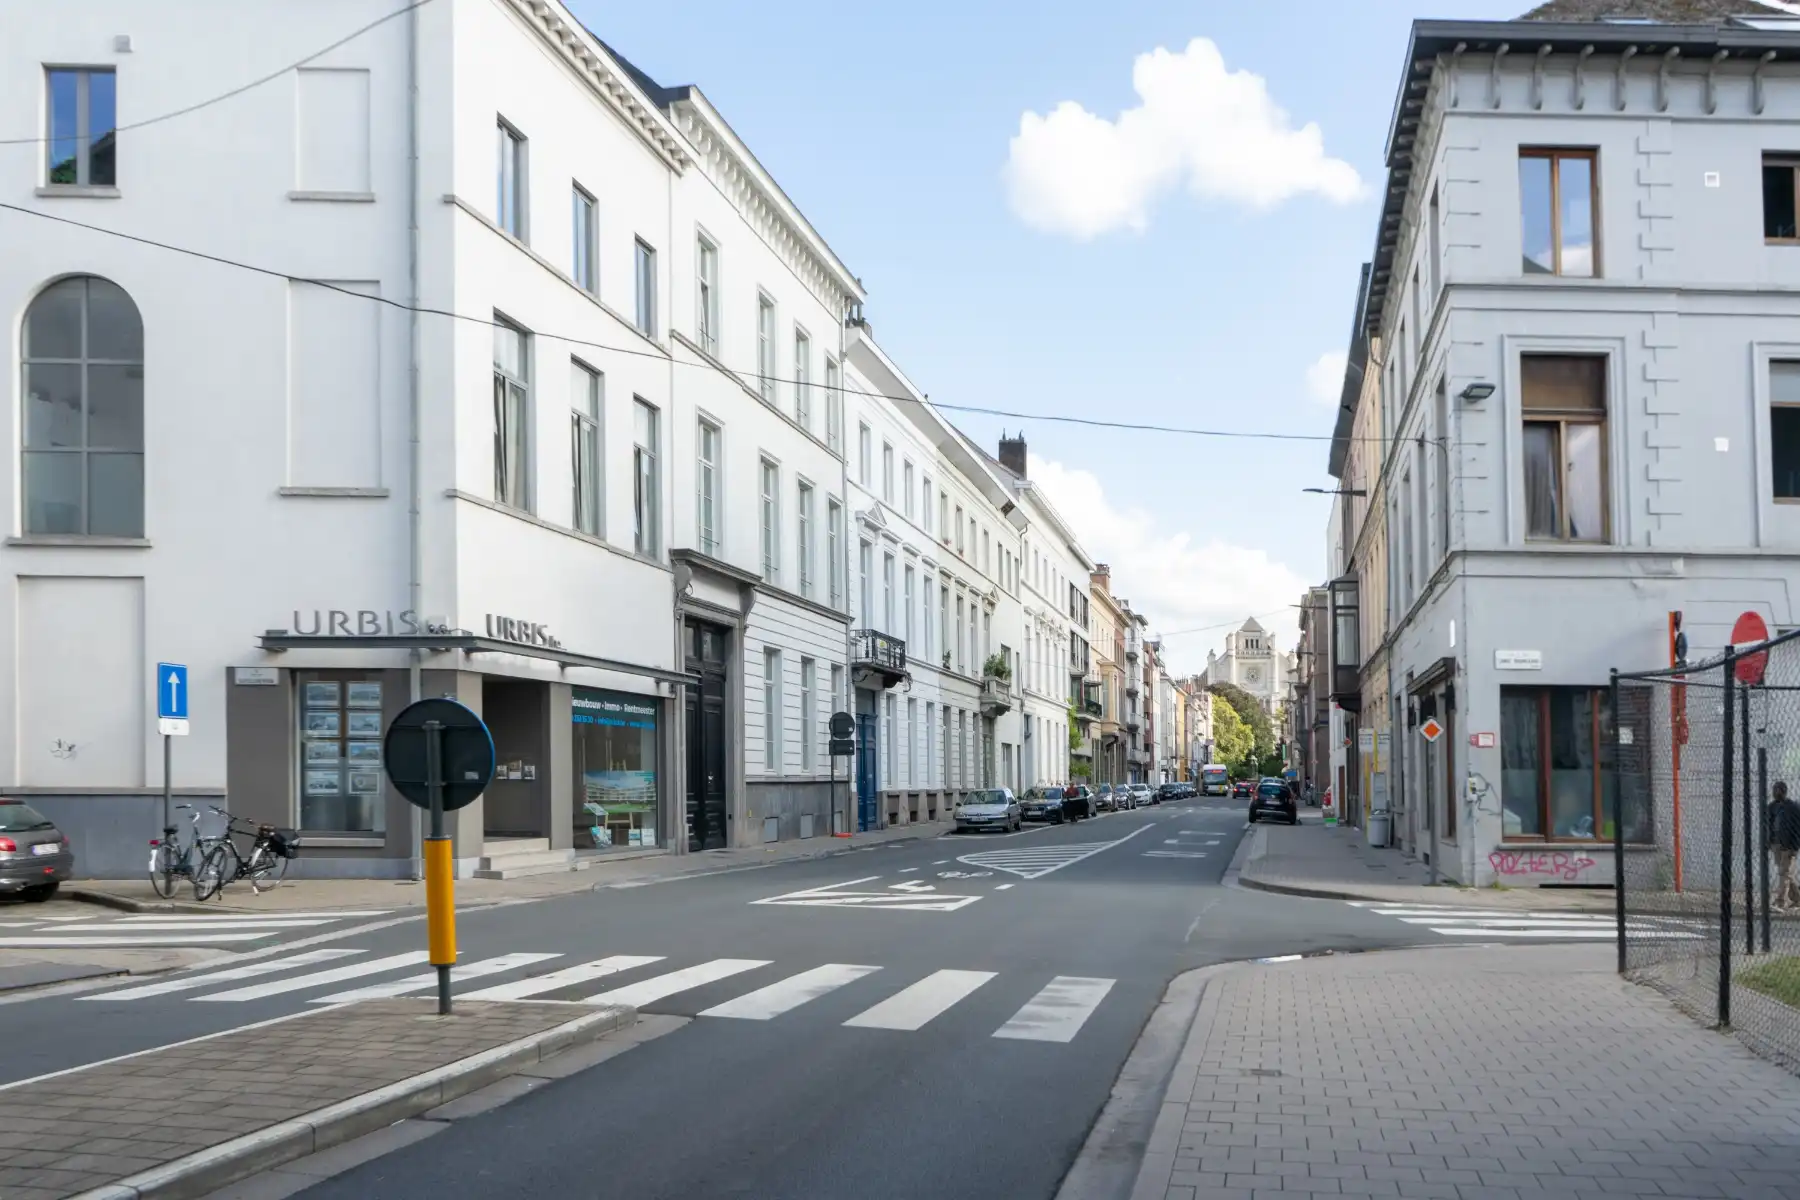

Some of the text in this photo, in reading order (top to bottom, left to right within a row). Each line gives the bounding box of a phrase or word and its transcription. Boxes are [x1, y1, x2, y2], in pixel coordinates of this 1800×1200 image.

[293, 609, 419, 636] URBIS
[485, 613, 548, 646] URBIS
[572, 697, 655, 716] ieuwbouw Immo Rentmeester
